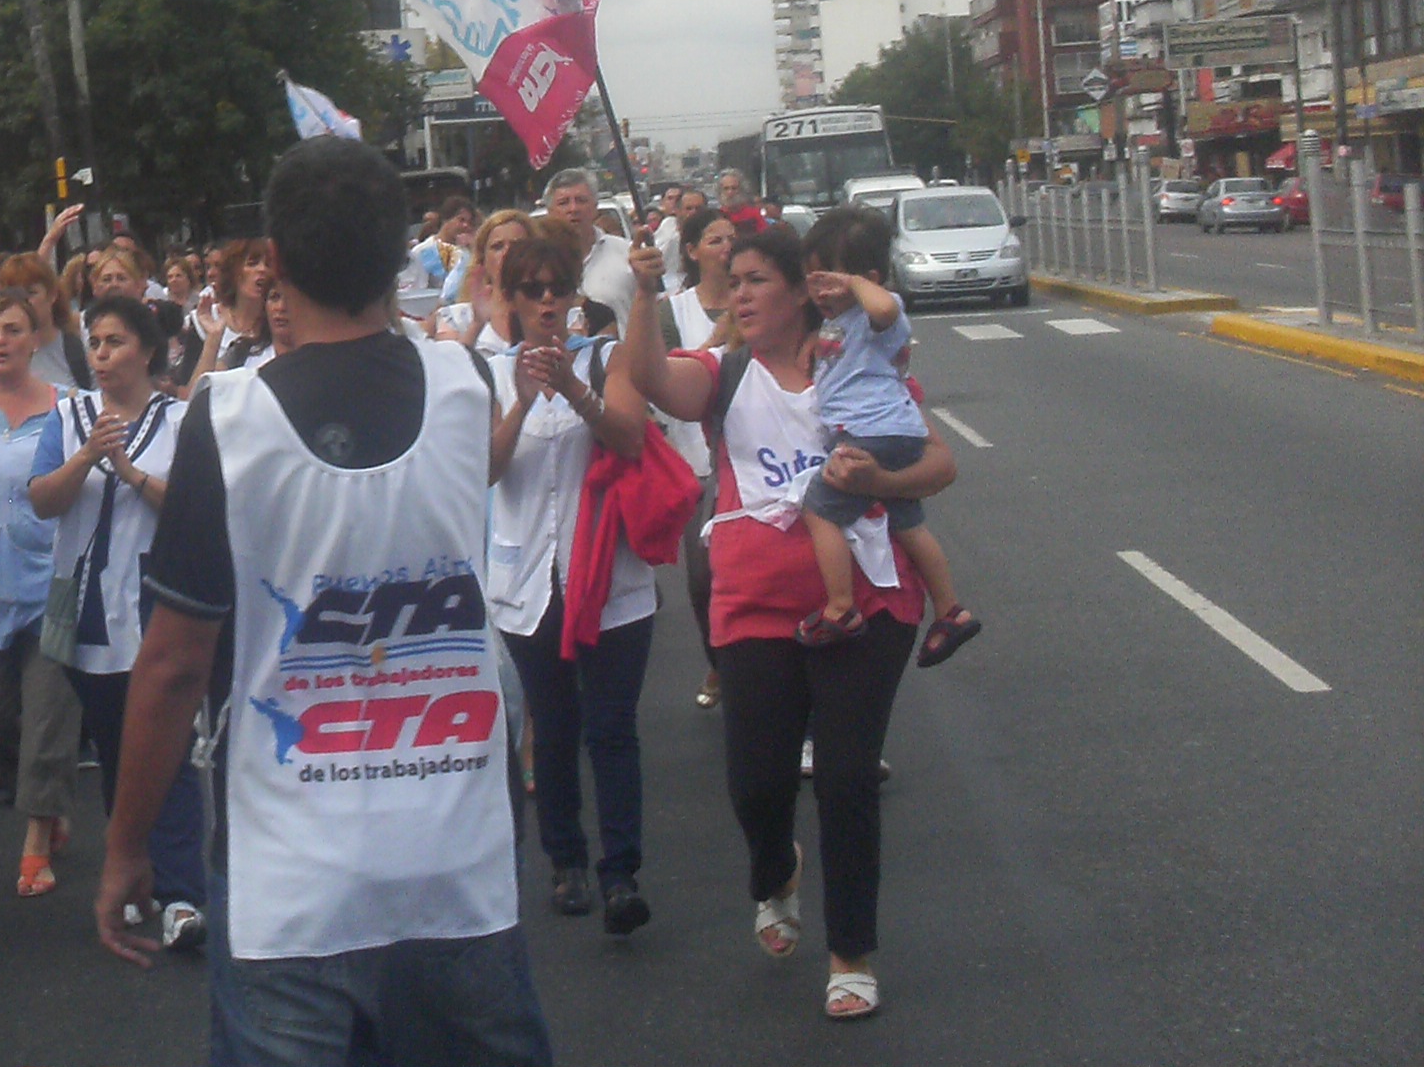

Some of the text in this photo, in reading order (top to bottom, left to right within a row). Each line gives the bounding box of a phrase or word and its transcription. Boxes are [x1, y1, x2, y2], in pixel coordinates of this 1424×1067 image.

[773, 118, 819, 138] 271
[295, 573, 487, 646] CTA
[283, 663, 480, 691] de los trabajadores
[294, 689, 500, 755] CTA
[299, 752, 489, 783] de los trabajadores
